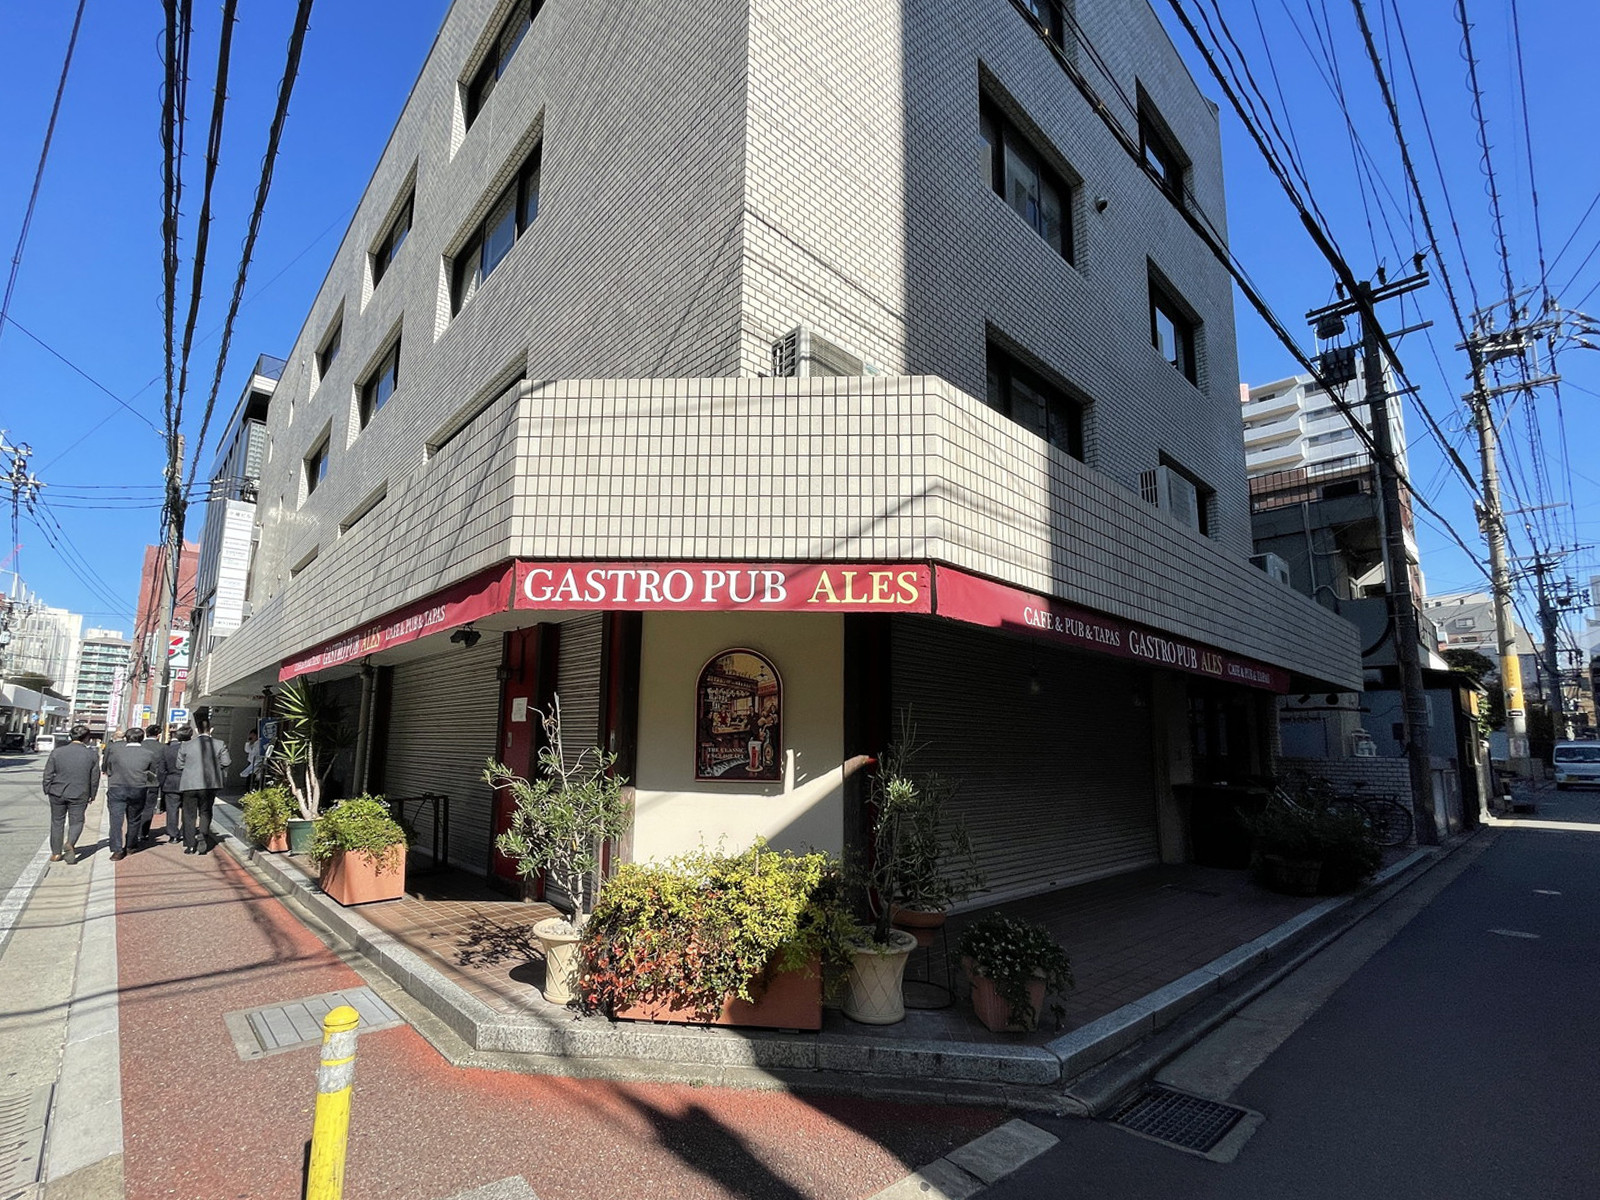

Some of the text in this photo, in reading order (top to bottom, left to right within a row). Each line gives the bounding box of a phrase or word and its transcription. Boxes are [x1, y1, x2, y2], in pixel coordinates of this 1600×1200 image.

[523, 568, 920, 605] GASTRO PUB ALES
[424, 604, 446, 627] TAPAS
[1023, 606, 1121, 647] CAFE & PUB & TAPAS
[1201, 651, 1223, 675] ALES
[170, 709, 187, 722] P
